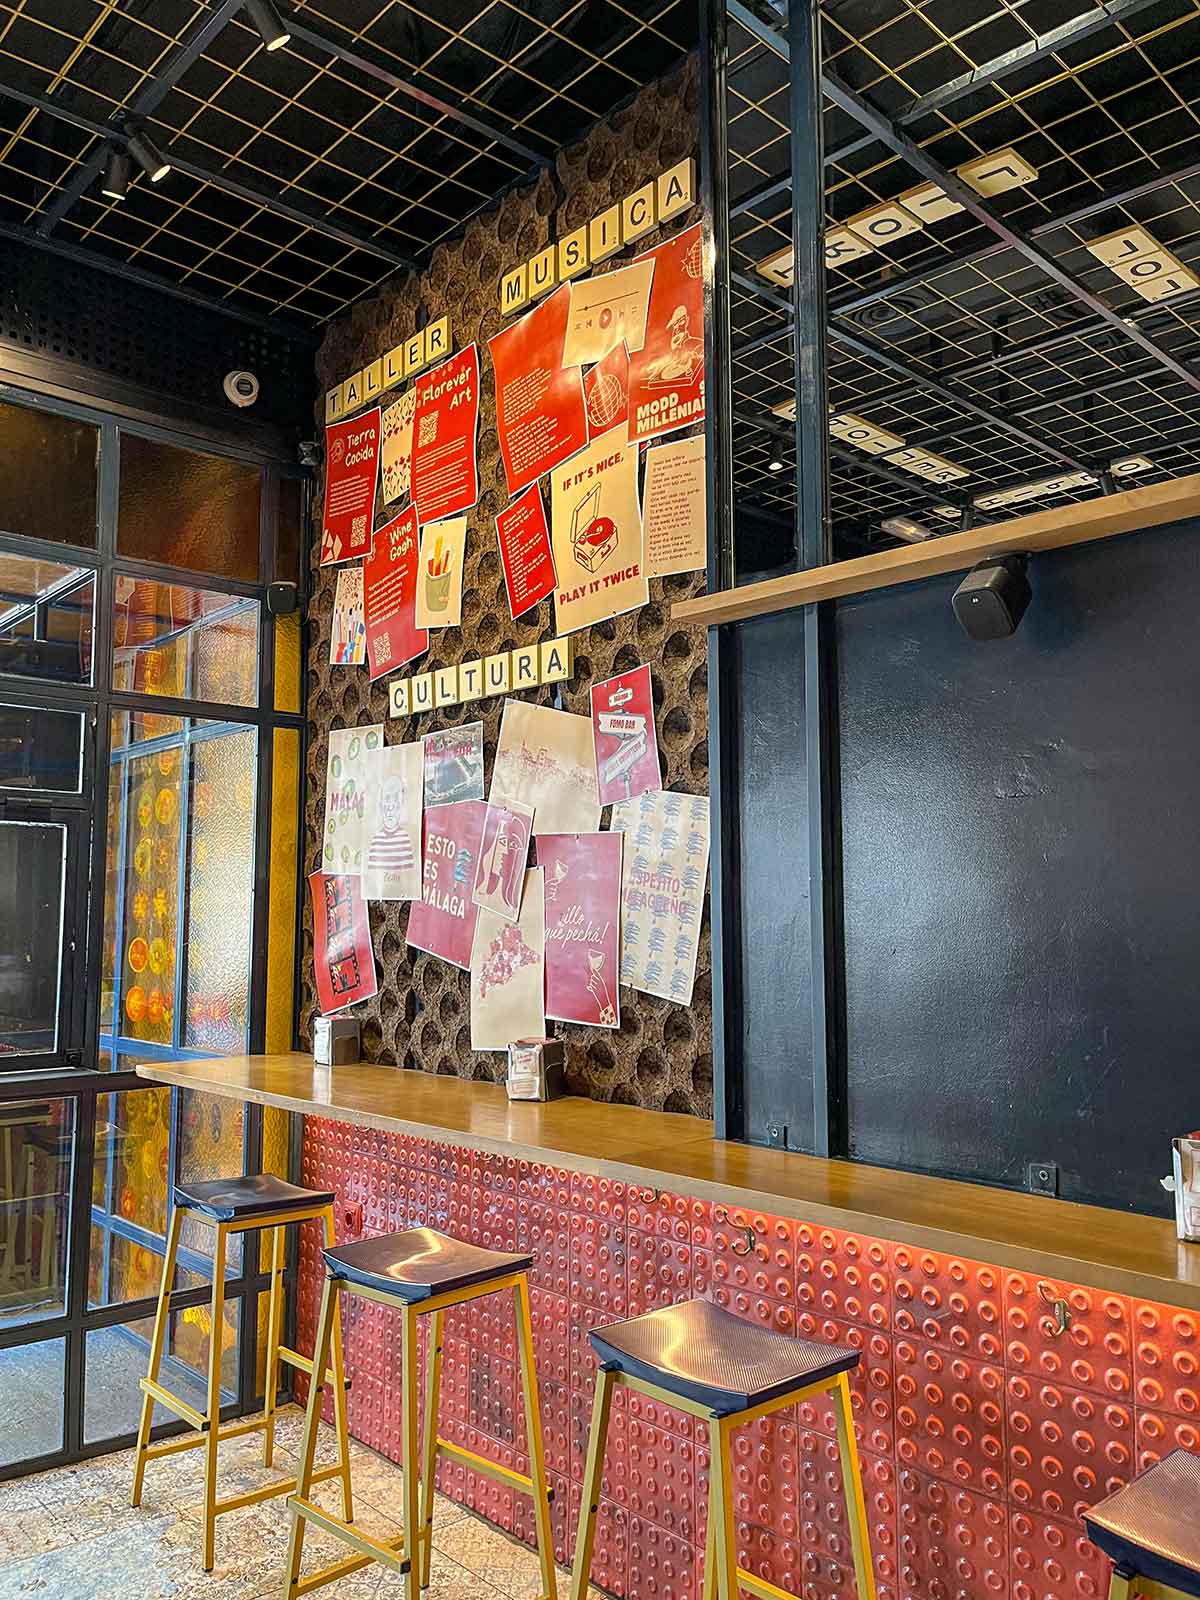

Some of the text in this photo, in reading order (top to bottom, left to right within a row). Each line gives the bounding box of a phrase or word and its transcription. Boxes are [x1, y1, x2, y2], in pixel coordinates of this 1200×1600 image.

[507, 176, 683, 304] MUSICA
[330, 328, 441, 413] TALLER
[422, 367, 472, 407] Florever
[450, 386, 472, 410] Art
[347, 428, 376, 449] Tierra
[345, 444, 374, 467] Cocida
[563, 452, 624, 491] IF IT'S NICE,
[389, 520, 412, 545] Wine
[390, 535, 413, 562] Gogh
[560, 564, 640, 605] PLAY IT TWICE
[394, 648, 562, 708] CULTURA
[610, 719, 636, 729] FOMO BAR
[427, 832, 456, 859] ESTO
[423, 858, 439, 880] ES
[561, 920, 610, 949] pechá!
